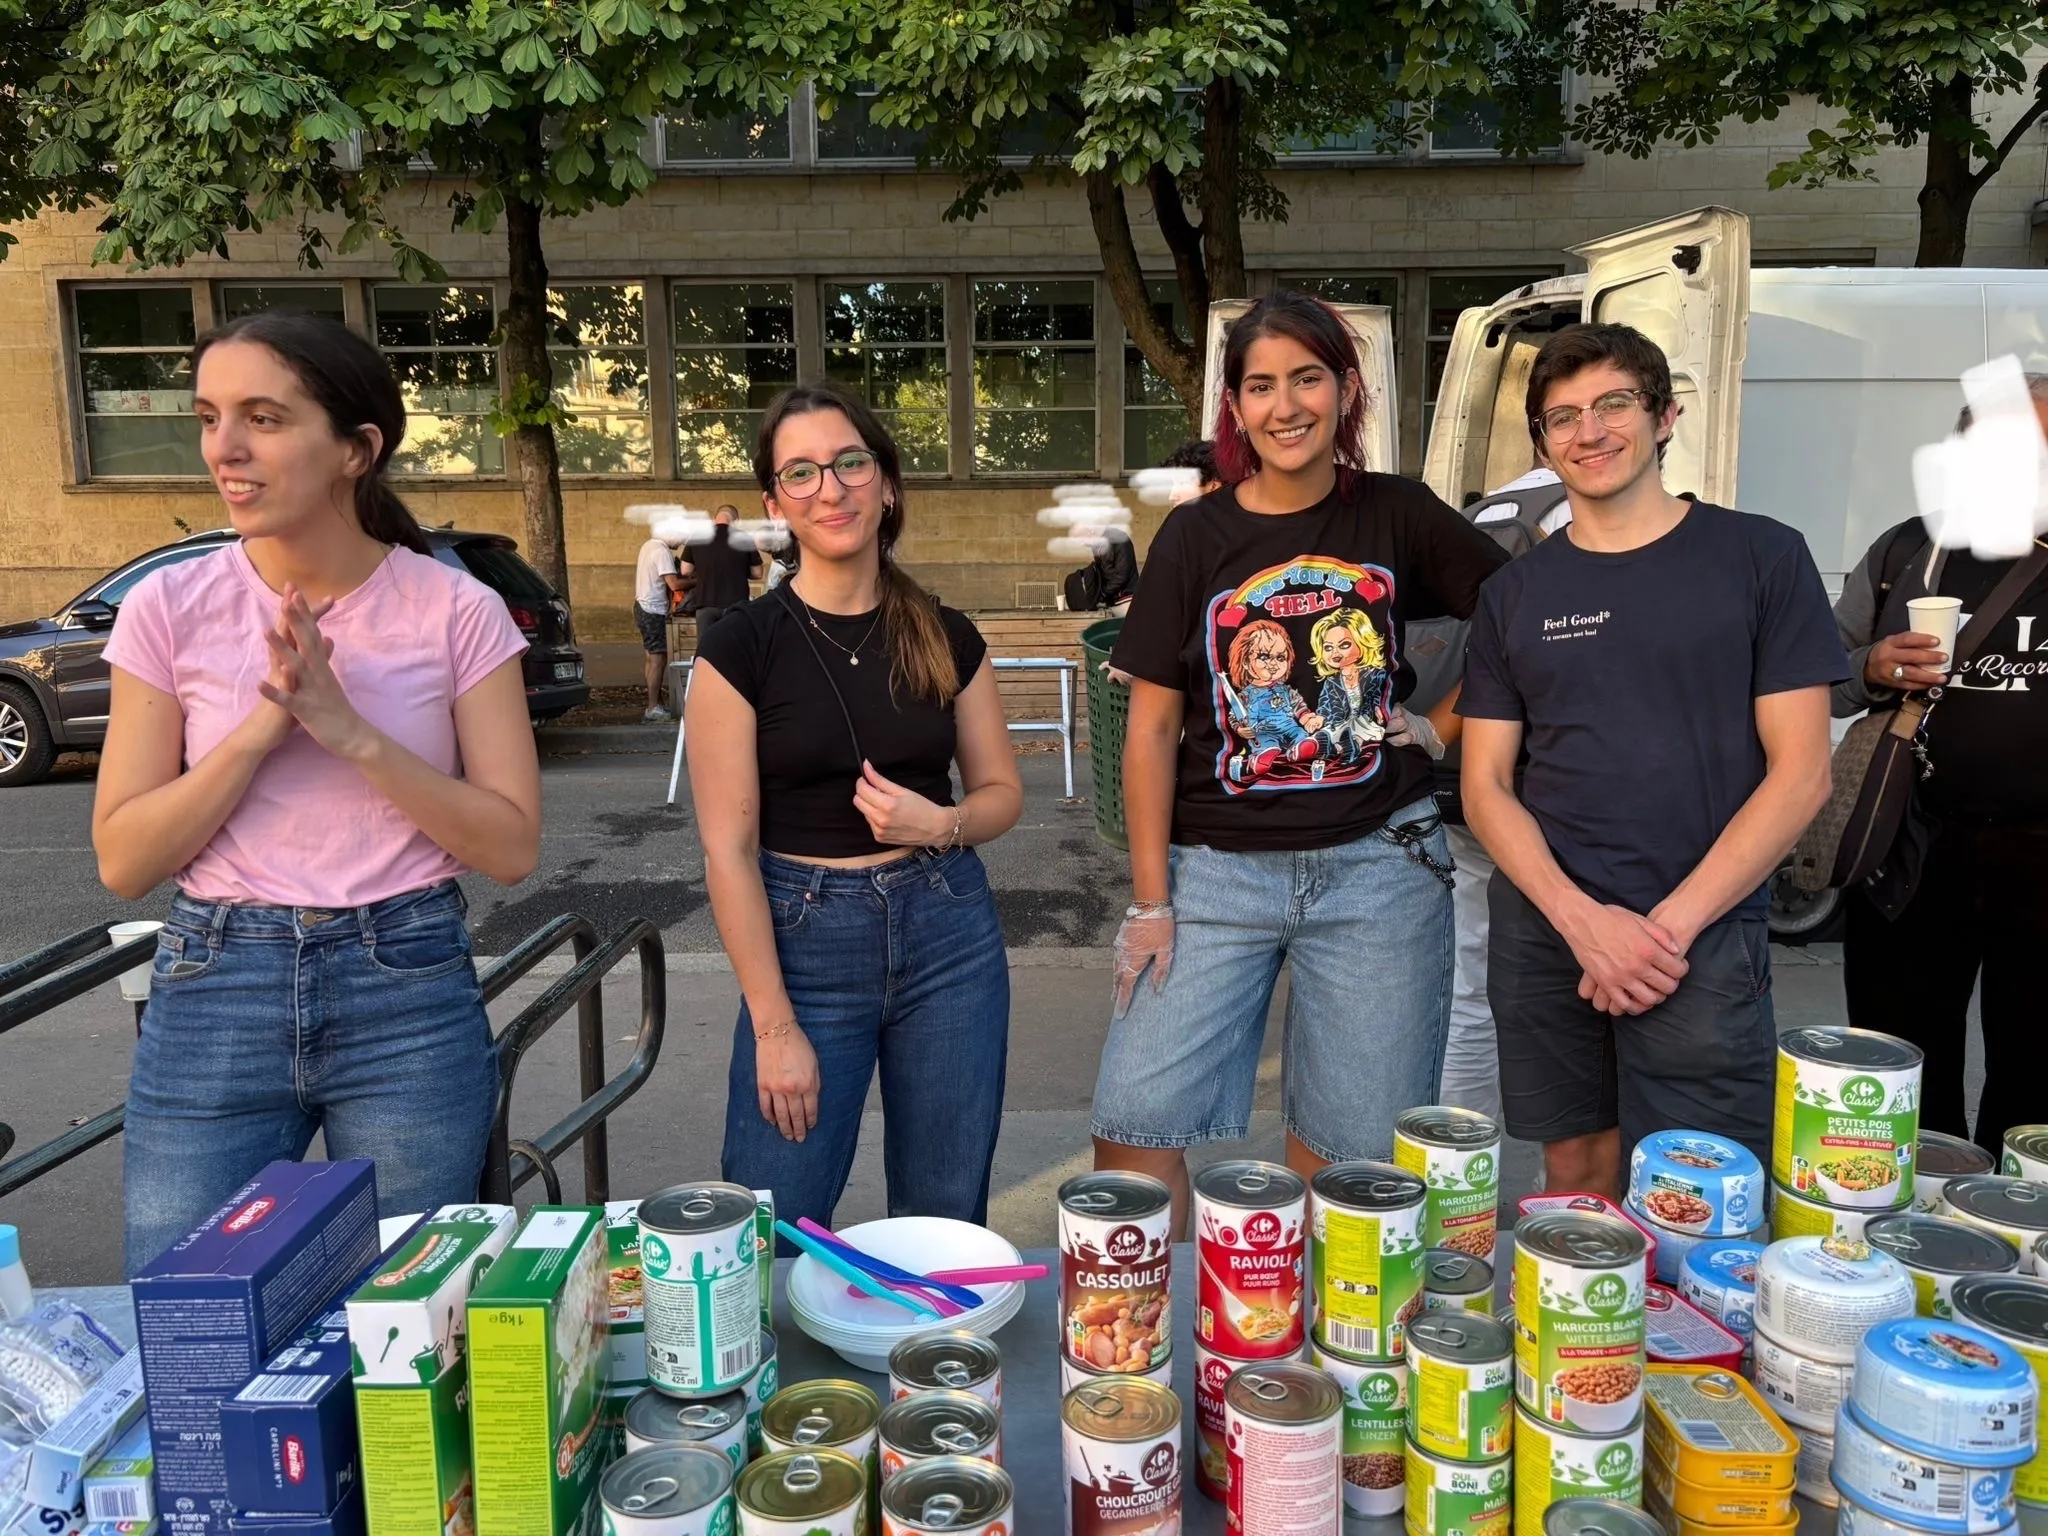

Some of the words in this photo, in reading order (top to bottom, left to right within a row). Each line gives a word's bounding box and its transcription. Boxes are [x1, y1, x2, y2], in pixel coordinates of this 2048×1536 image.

[1246, 577, 1285, 607] See
[1283, 566, 1325, 586] You
[1325, 568, 1352, 592] in
[1264, 589, 1342, 617] HELL
[1543, 616, 1567, 631] Feel
[1975, 654, 2048, 680] Recor
[1827, 1117, 1866, 1128] PETITS
[1868, 1120, 1892, 1130] POIS
[1827, 1126, 1836, 1135] &
[1838, 1128, 1893, 1139] CAROTTES
[228, 1183, 261, 1204] PENNE
[1438, 1193, 1483, 1207] HARICOTS
[228, 1200, 270, 1230] Barilla
[1448, 1203, 1478, 1215] WITTE
[197, 1207, 233, 1231] RIGATE
[1229, 1253, 1291, 1270] RAVIOLI
[1076, 1264, 1168, 1289] CASSOULET
[1262, 1279, 1281, 1287] RUND
[1552, 1321, 1611, 1333] HARICOTS
[1565, 1333, 1604, 1344] WITTE
[1576, 1348, 1604, 1356] TOMATE
[671, 1376, 686, 1385] 425
[687, 1377, 698, 1385] ml
[1197, 1391, 1225, 1416] RAVI
[1351, 1417, 1404, 1429] LENTILLES
[1360, 1430, 1397, 1441] LINZEN
[269, 1426, 282, 1472] CAPELLINI
[287, 1440, 302, 1481] Barilla
[1095, 1482, 1172, 1508] CHOUCROUTE
[1099, 1499, 1166, 1520] GEGARNEERDE
